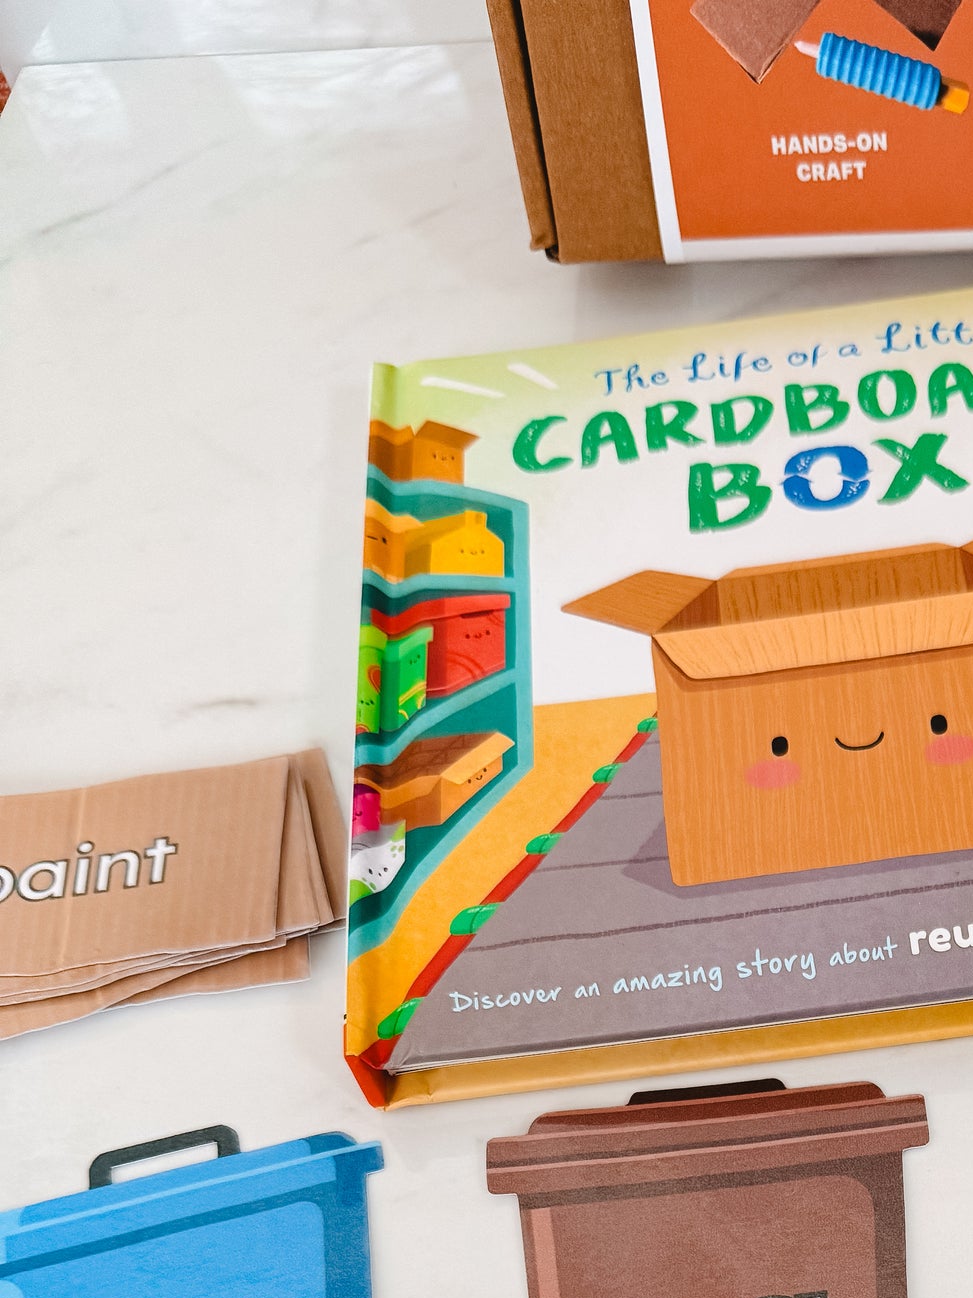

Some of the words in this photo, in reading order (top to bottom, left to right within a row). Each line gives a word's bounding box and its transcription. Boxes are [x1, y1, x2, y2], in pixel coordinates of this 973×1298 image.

[771, 132, 888, 156] HANDS-ON
[796, 160, 867, 183] CRAFT
[596, 364, 669, 395] The
[682, 352, 772, 382] Life
[787, 343, 826, 367] of
[839, 341, 861, 357] a
[688, 432, 970, 534] BOX
[449, 986, 561, 1012] Discover
[575, 982, 600, 999] an
[613, 963, 723, 992] amazing
[736, 948, 817, 979] story
[829, 936, 897, 967] about
